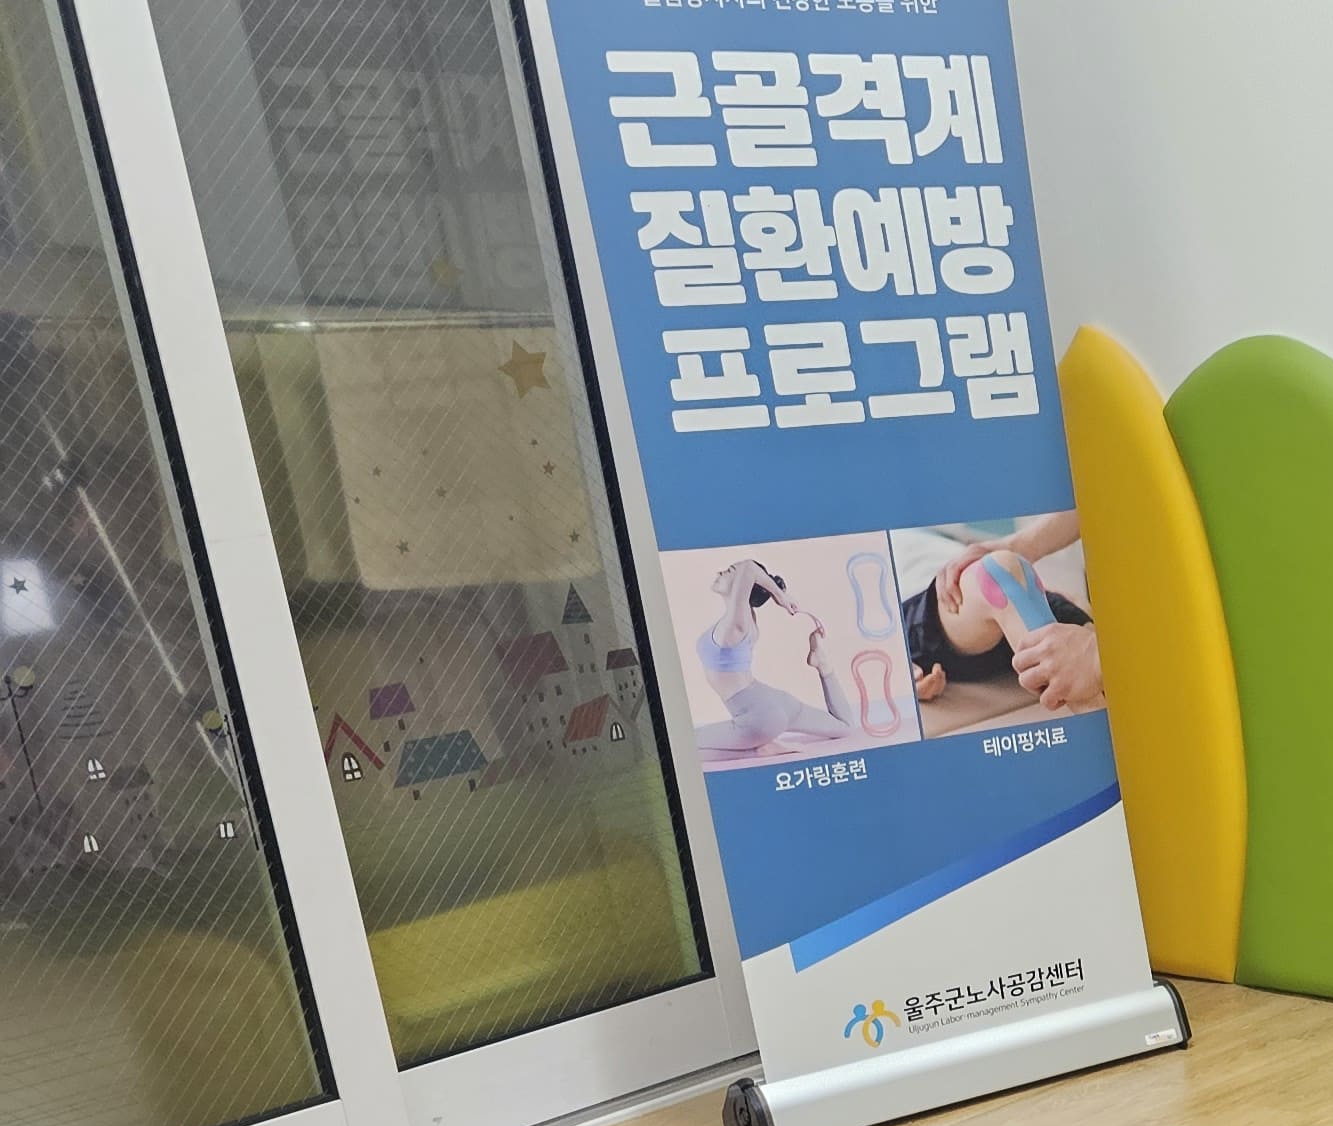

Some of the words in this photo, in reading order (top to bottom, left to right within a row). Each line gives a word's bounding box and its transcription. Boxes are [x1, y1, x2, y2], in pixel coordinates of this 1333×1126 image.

[605, 50, 1003, 167] 근골격계
[629, 186, 1014, 306] 질환예방
[662, 312, 1039, 432] 프로그램
[982, 727, 1068, 757] 테이핑치료
[775, 758, 868, 791] 요가링훈련
[903, 958, 1085, 1022] 울주군노사공감센터
[1060, 984, 1084, 997] Center
